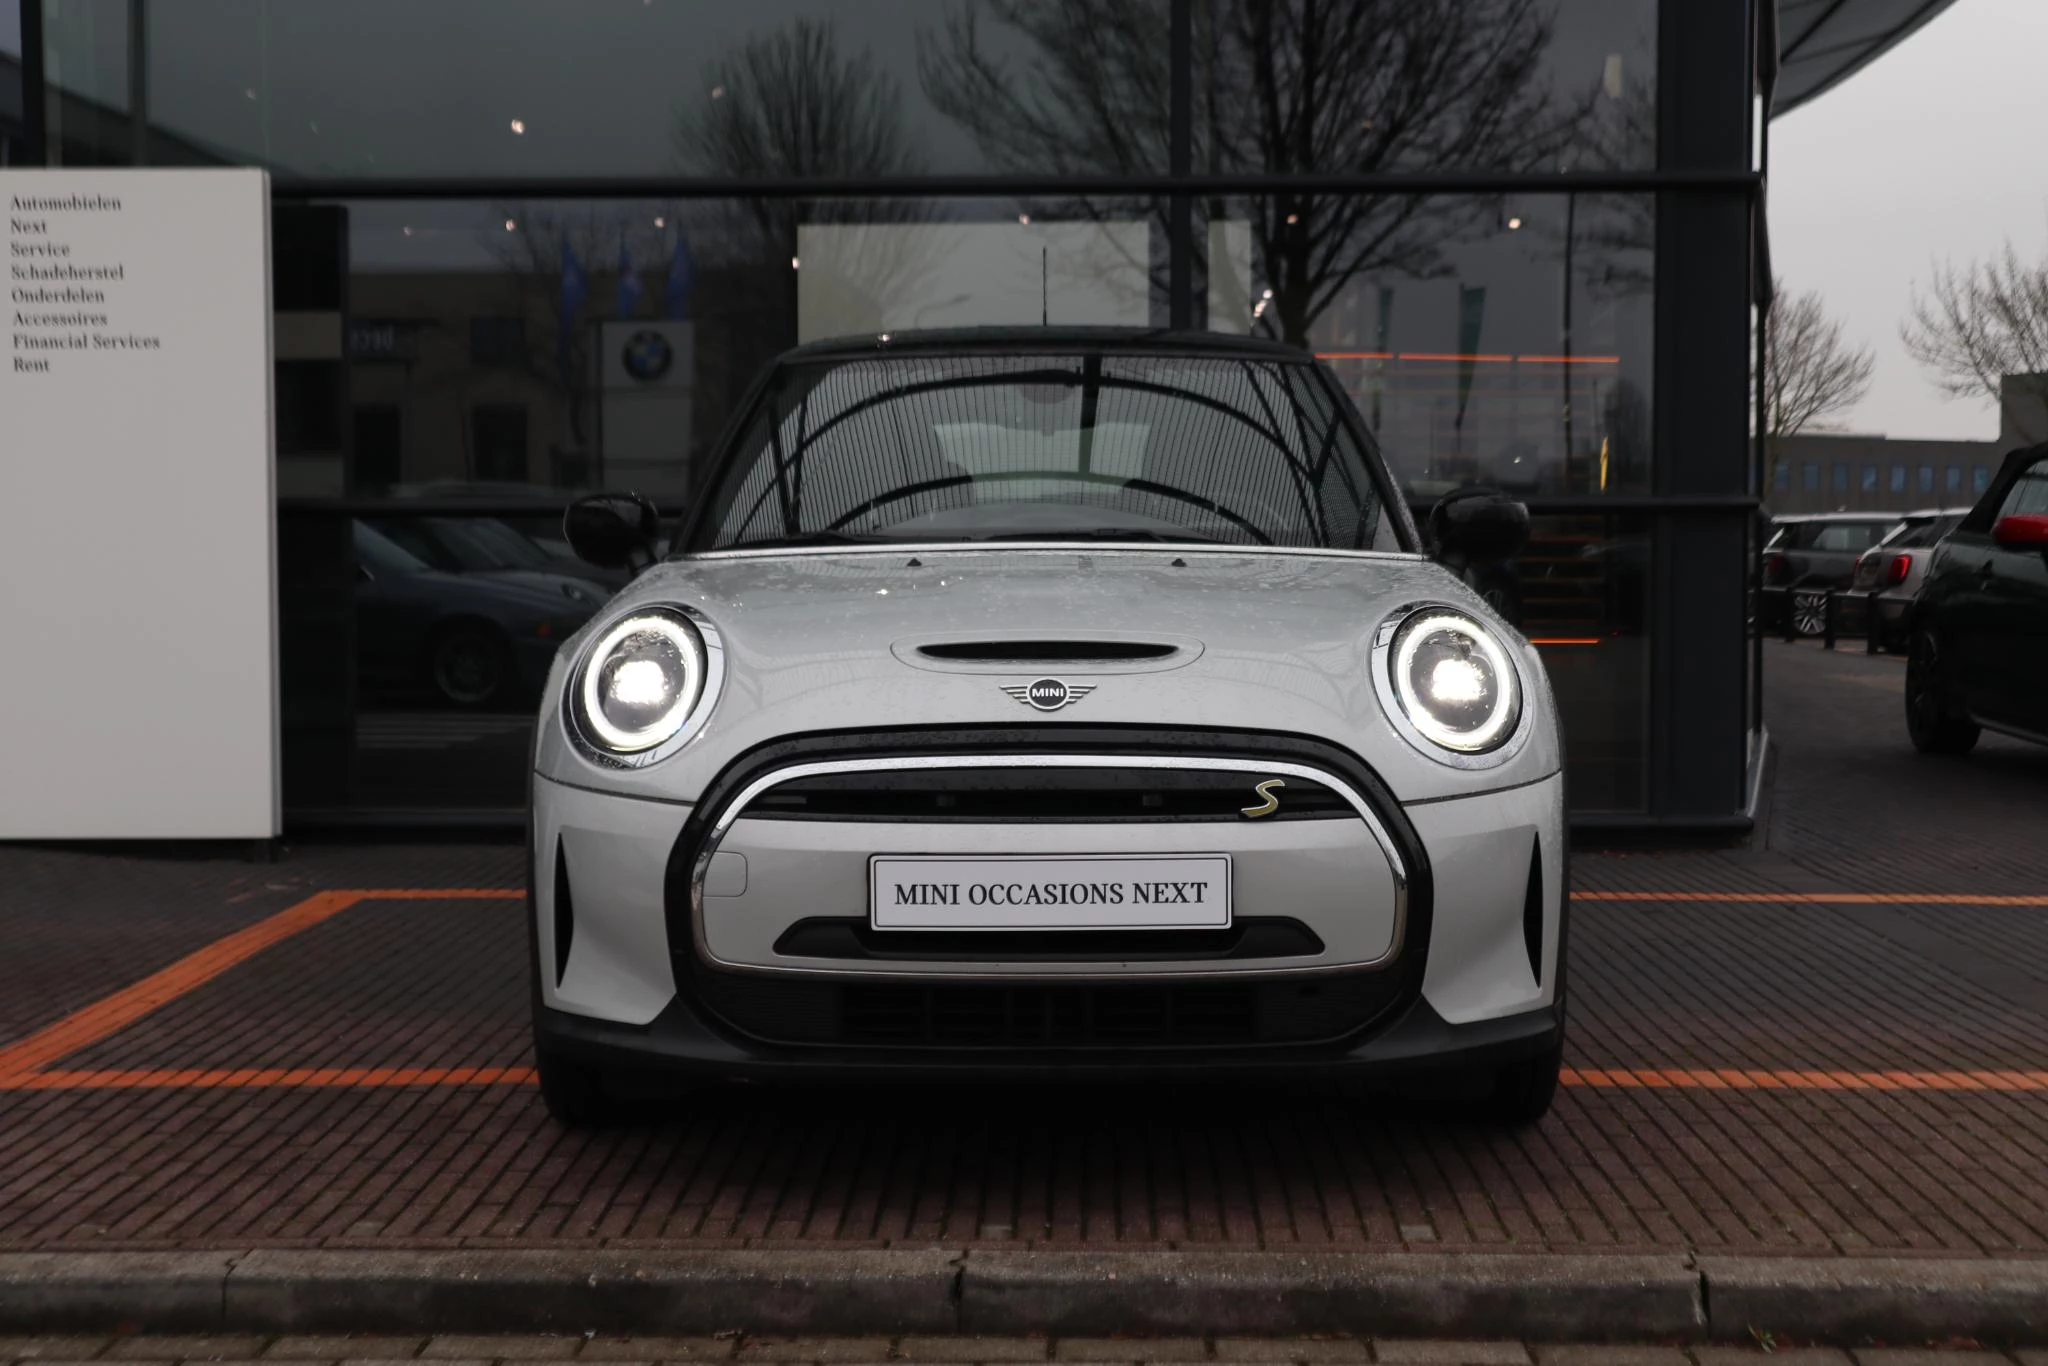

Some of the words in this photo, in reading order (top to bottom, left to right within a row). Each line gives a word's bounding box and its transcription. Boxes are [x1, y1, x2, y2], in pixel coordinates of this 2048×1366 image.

[11, 193, 122, 211] Automobielen
[11, 217, 48, 234] Next
[11, 241, 71, 258] Service
[11, 263, 125, 281] Schadeherstel
[11, 286, 105, 304] Onderdelen
[13, 310, 108, 327] Accessoires
[13, 332, 88, 350] Financial
[92, 331, 161, 350] Services
[13, 356, 50, 373] Rent
[1031, 687, 1064, 698] MINI
[894, 883, 960, 906] MINI
[968, 883, 1124, 905] OCCASIONS
[1132, 881, 1209, 904] NEXT
